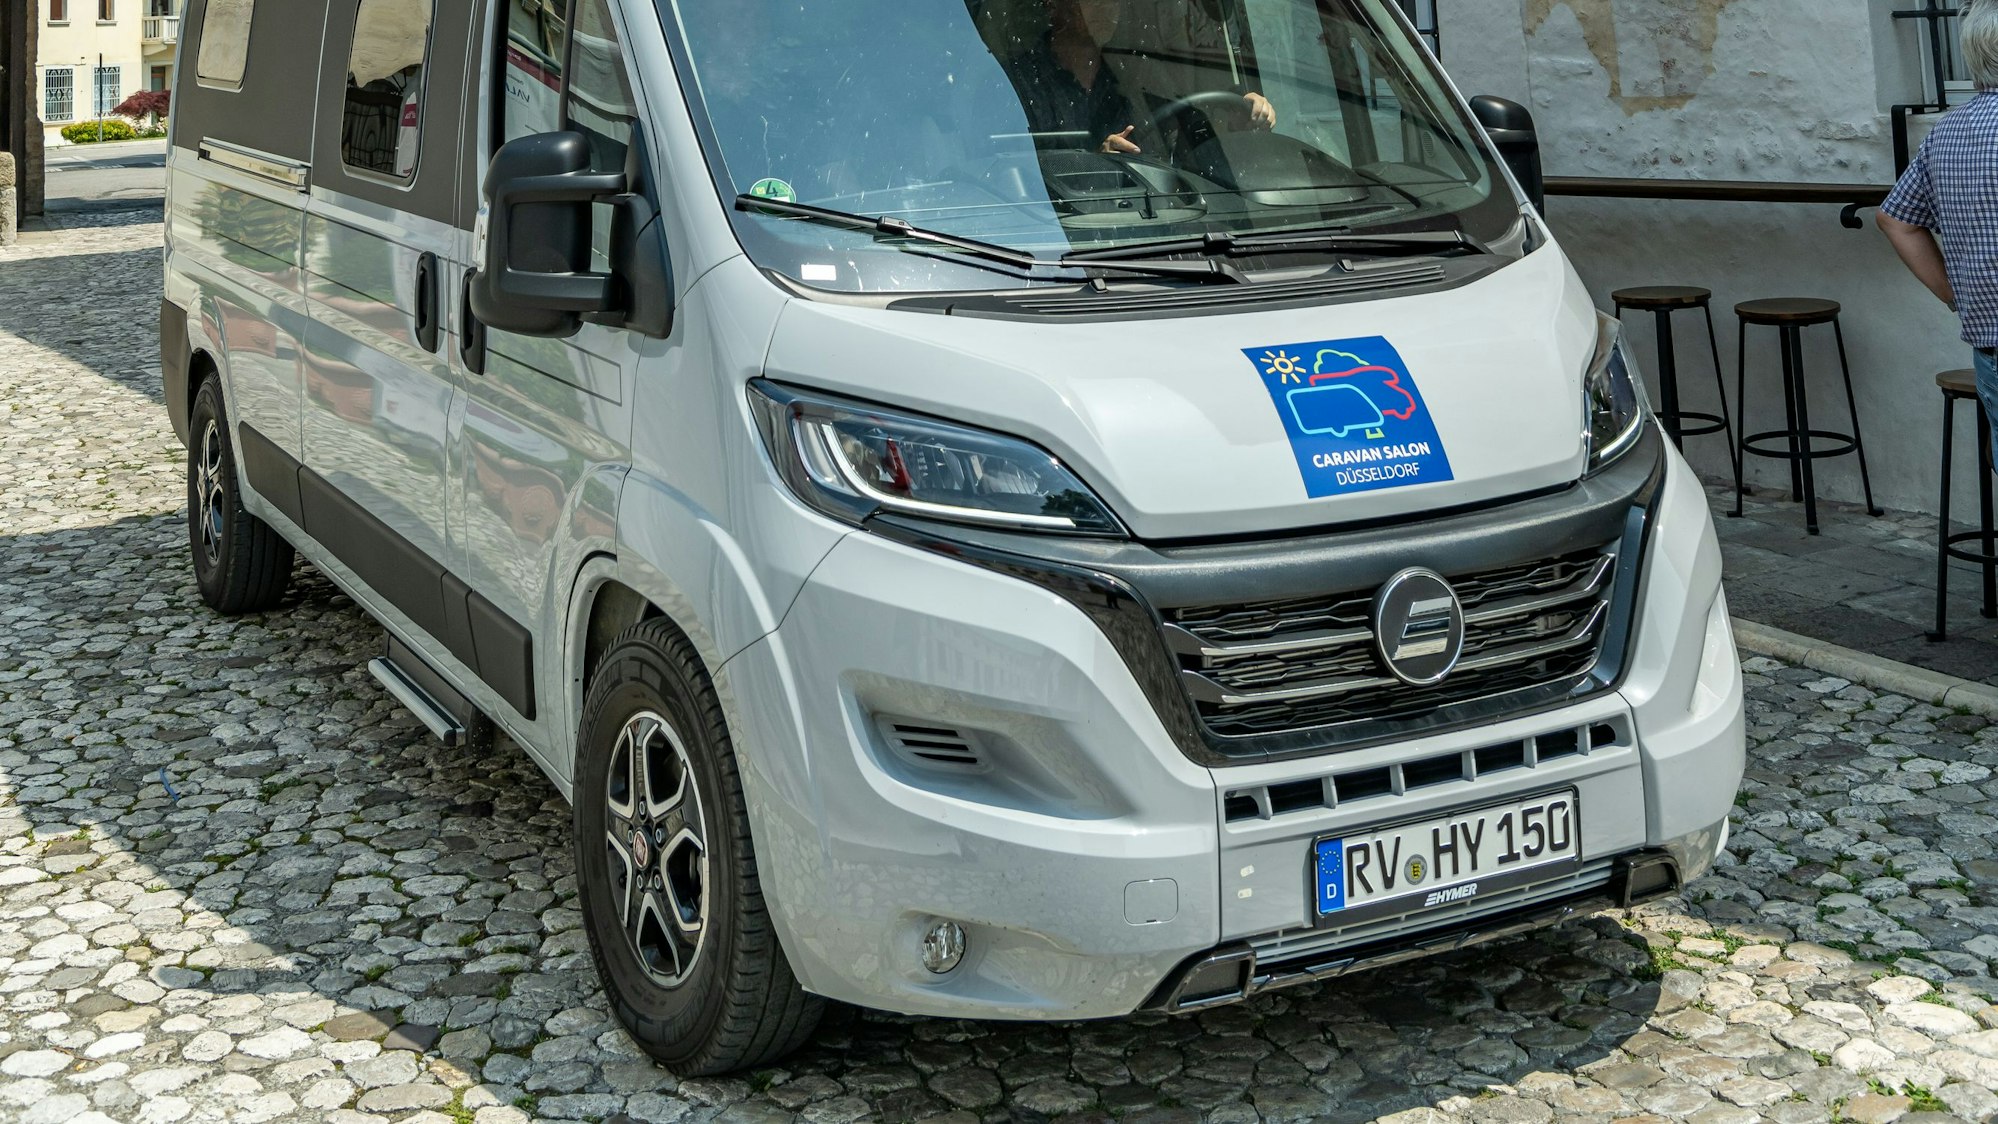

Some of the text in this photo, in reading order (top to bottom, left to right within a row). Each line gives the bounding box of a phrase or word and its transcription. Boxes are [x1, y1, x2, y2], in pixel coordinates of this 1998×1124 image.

[765, 180, 779, 197] 4
[1312, 441, 1431, 468] CARAVAN SALON
[1335, 462, 1420, 486] DÜSSELDORF
[1346, 835, 1401, 898] RV
[1432, 816, 1486, 879] HY
[1497, 799, 1570, 866] 150
[1326, 882, 1337, 899] D
[1435, 883, 1478, 905] HYMER
